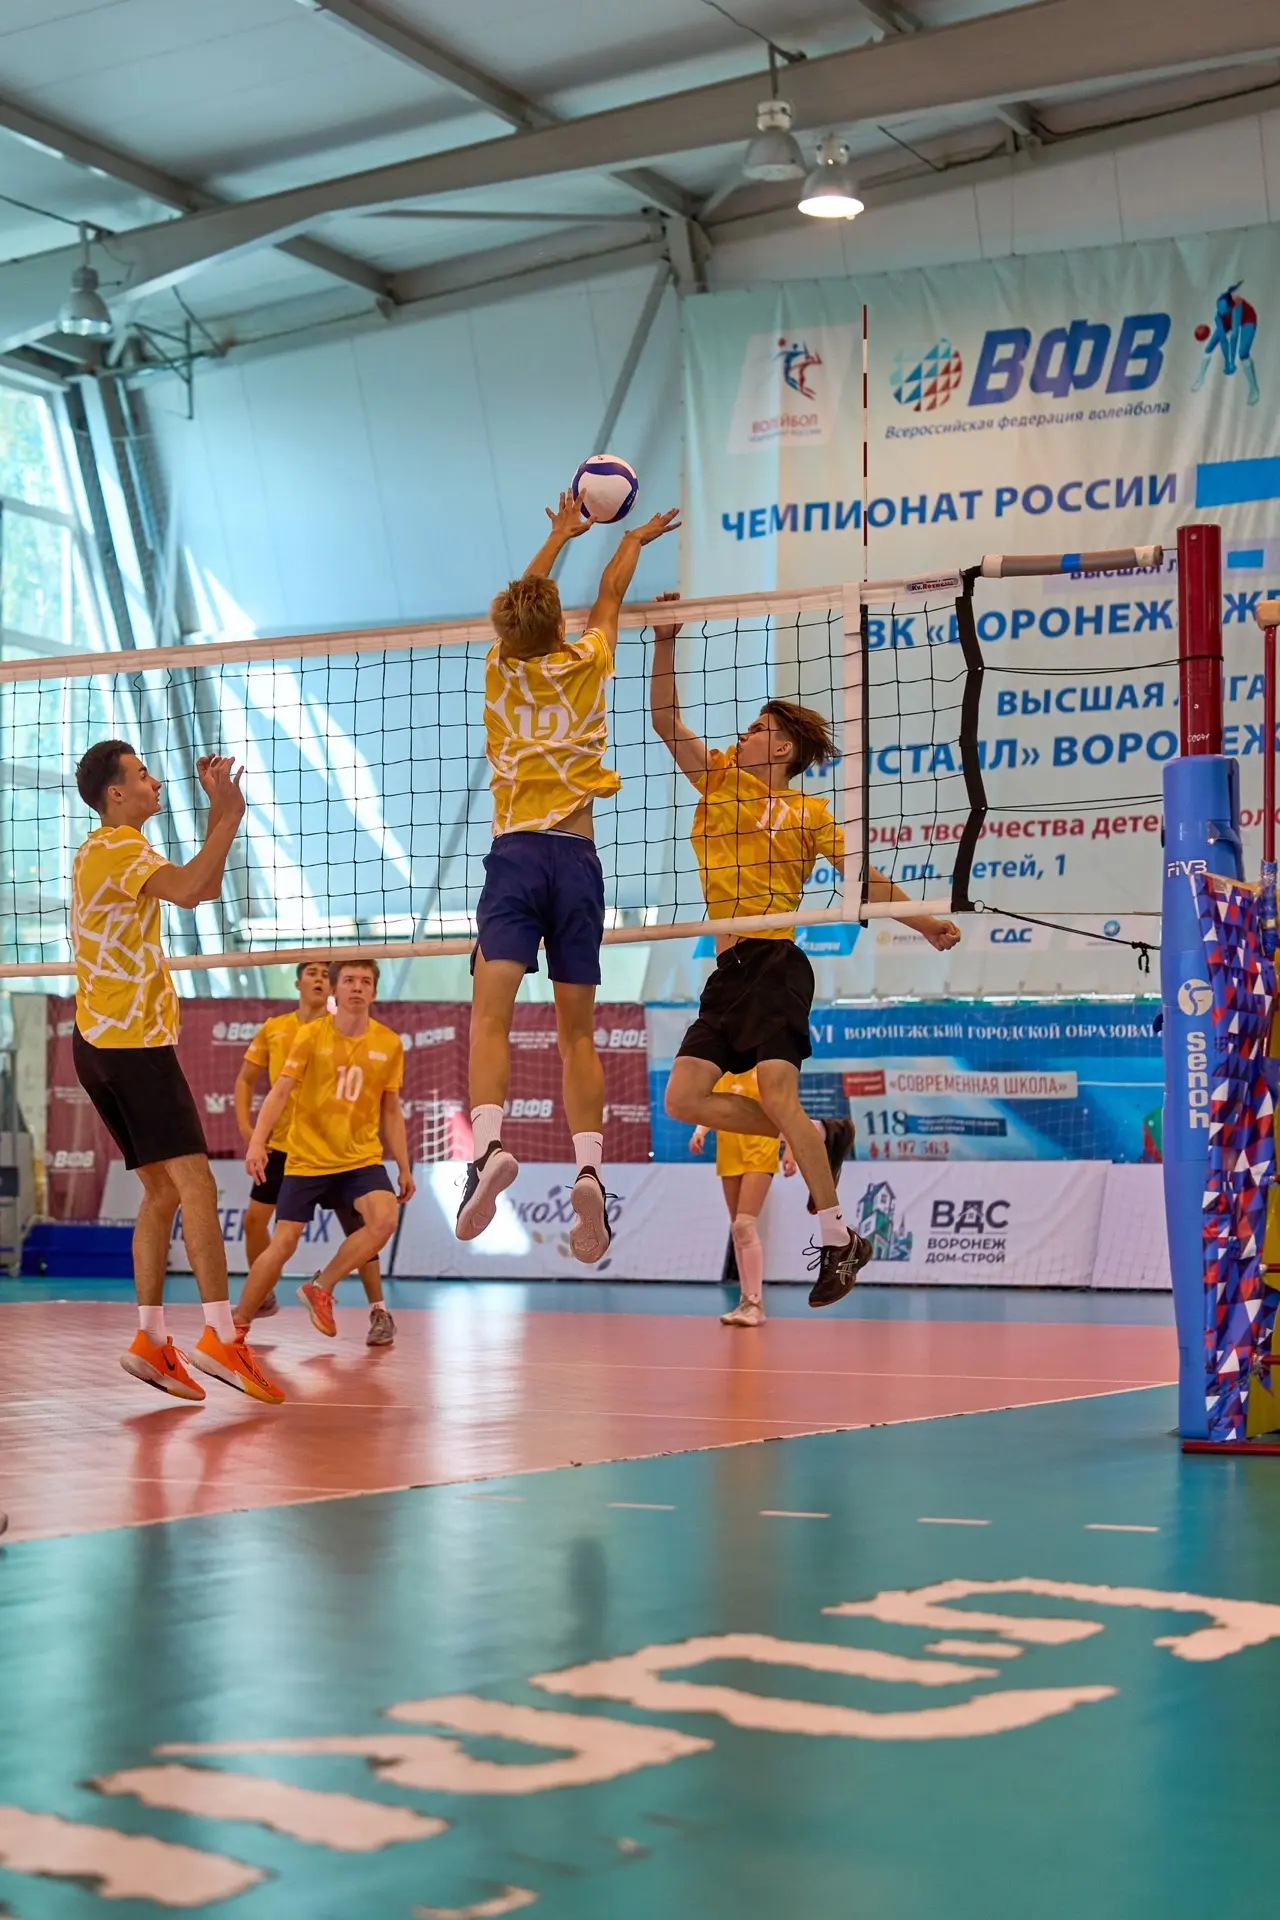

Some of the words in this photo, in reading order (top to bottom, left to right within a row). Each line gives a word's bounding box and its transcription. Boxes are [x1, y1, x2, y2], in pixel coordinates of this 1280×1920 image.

[968, 312, 1172, 406] ВФВ
[885, 420, 994, 440] Всероссийская
[998, 409, 1083, 431] федерация
[1088, 401, 1171, 422] волейбола
[720, 489, 983, 542] ЧЕМПИОНАТ
[994, 473, 1178, 518] РОССИИ
[997, 681, 1165, 717] ВЫСШАЯ
[1091, 814, 1165, 840] дете
[1054, 853, 1066, 875] 1
[844, 1024, 964, 1040] ВОРОНЕЖСКИЙ
[967, 1023, 1060, 1041] ГОРОДСКОЙ
[335, 1065, 364, 1102] 10
[889, 1074, 1000, 1095] «СОВРЕМЕННАЯ
[1004, 1077, 1068, 1095] ШКОЛА»
[1186, 1031, 1210, 1128] senoh
[511, 1098, 553, 1117] ВФВ
[864, 1110, 909, 1136] 118
[930, 1199, 1011, 1234] ВДС
[927, 1238, 1007, 1250] ВОРОНЕЖ
[925, 1251, 1006, 1264] ДОМ-СТРОЙ
